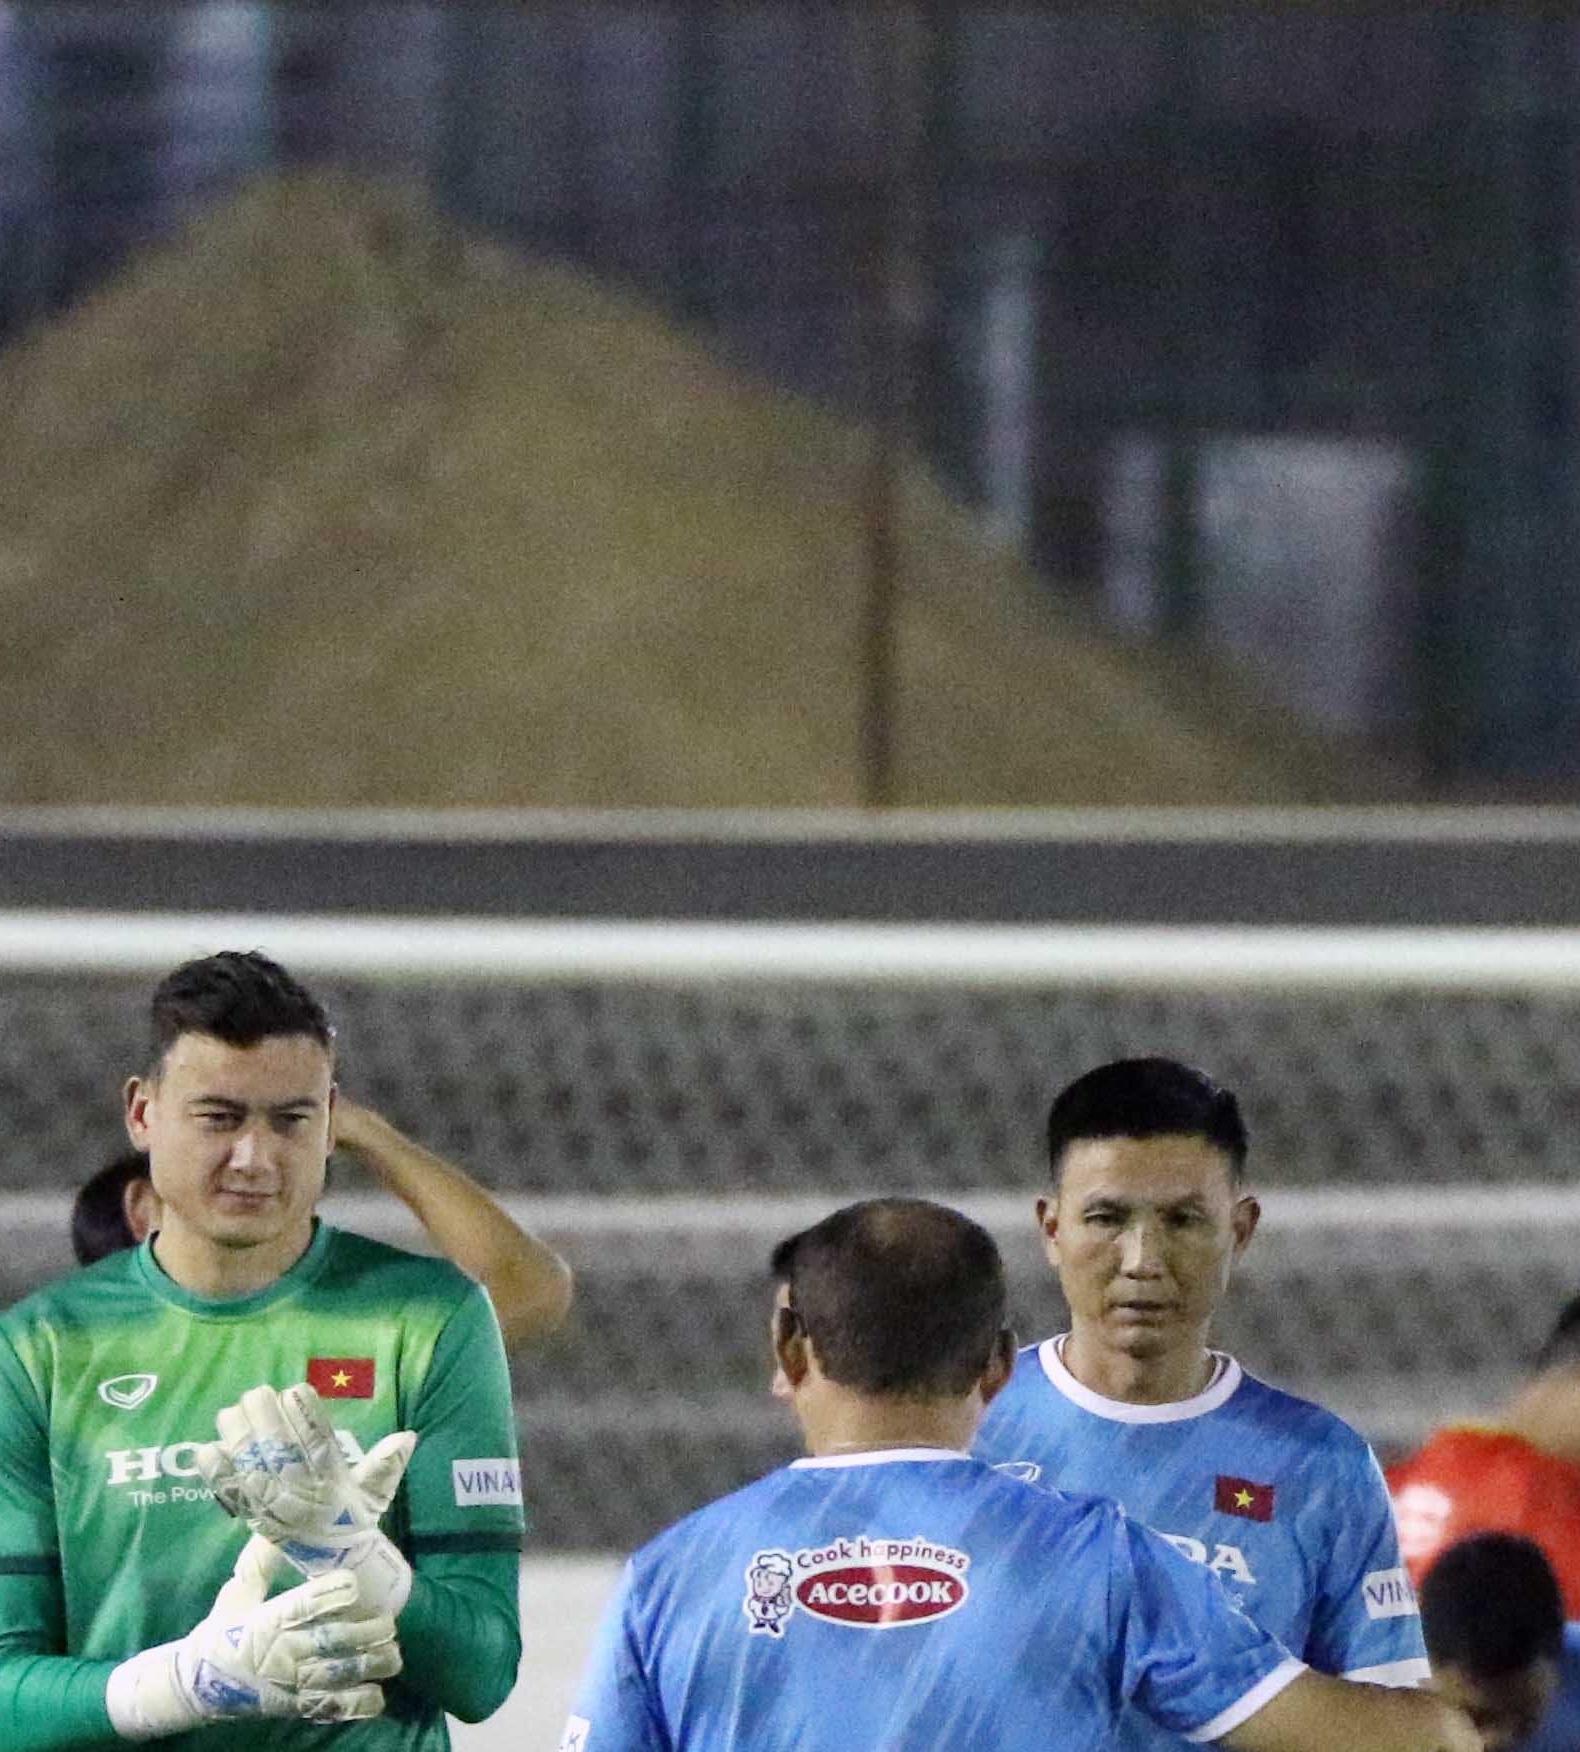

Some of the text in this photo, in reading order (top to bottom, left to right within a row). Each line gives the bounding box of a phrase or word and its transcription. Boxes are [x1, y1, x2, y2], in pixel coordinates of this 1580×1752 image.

[128, 1486, 218, 1507] The Pow
[797, 1540, 966, 1569] Cook happiness
